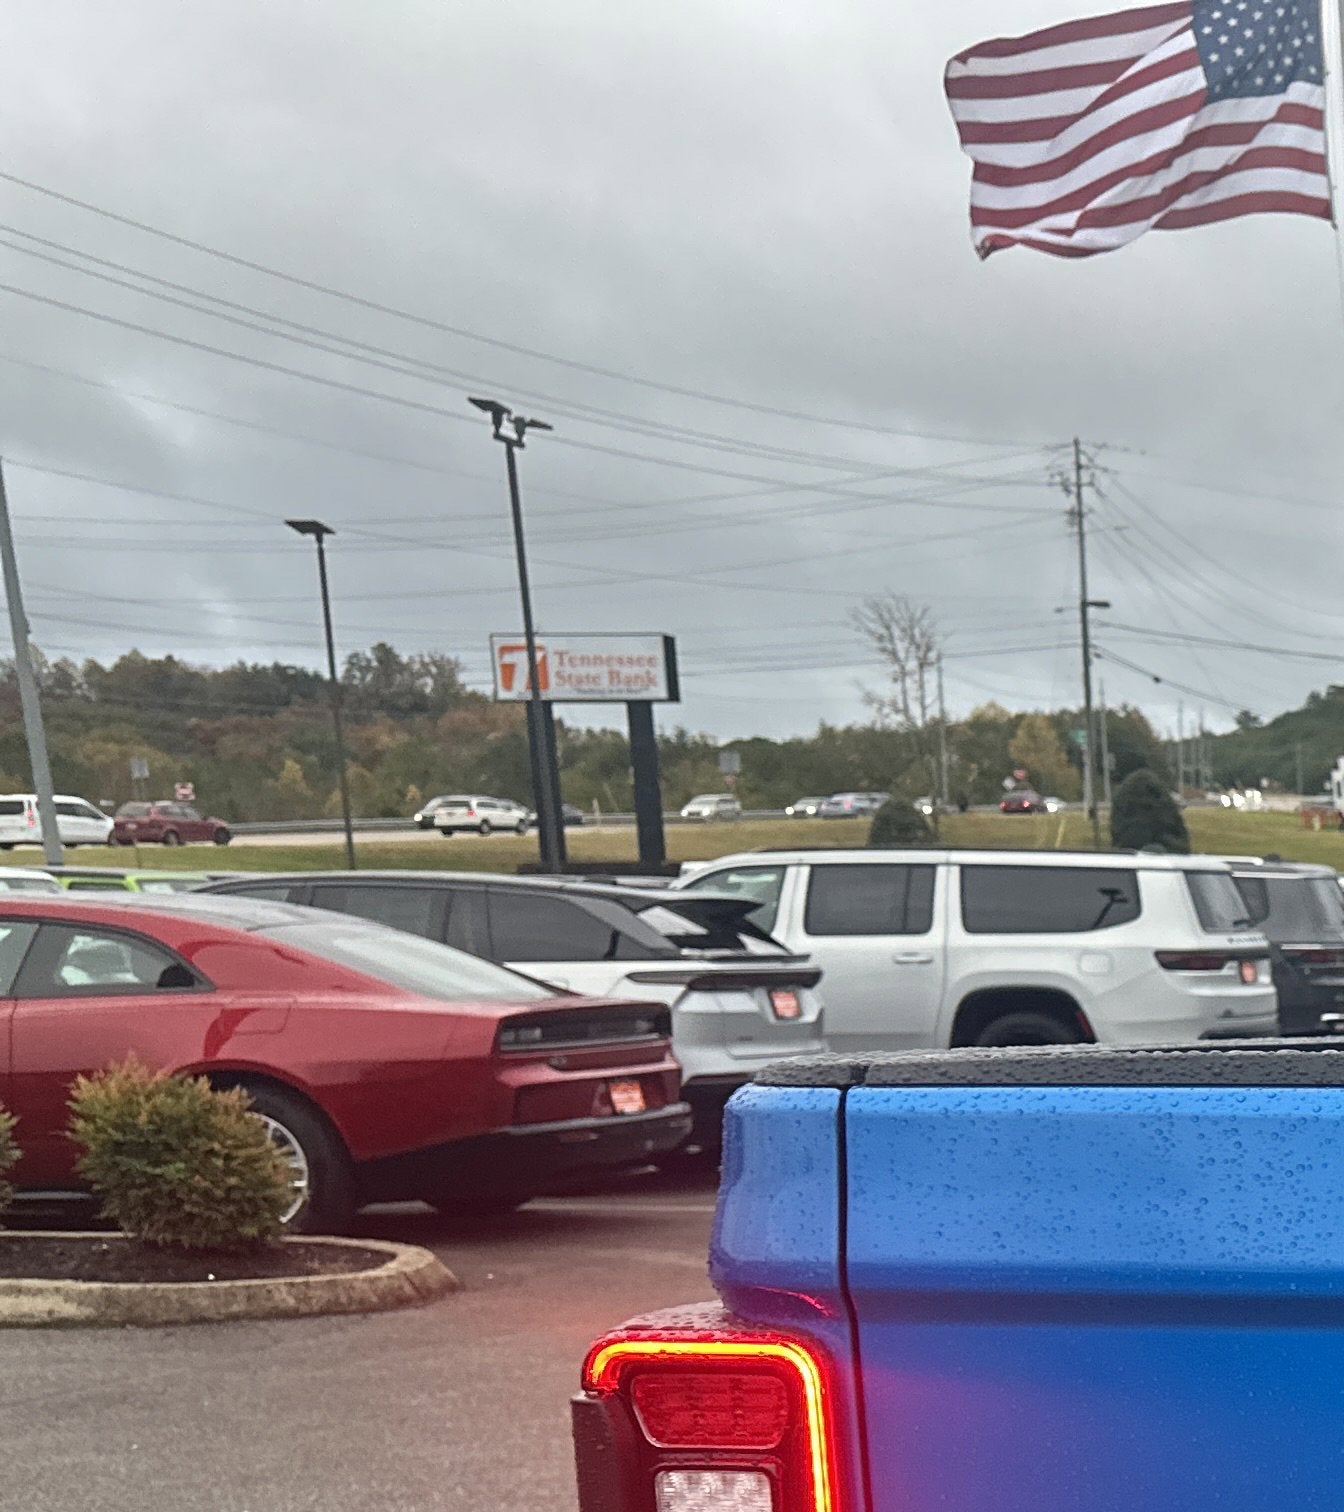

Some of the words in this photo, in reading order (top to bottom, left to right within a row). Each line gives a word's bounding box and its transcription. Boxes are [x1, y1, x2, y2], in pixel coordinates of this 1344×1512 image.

[553, 650, 657, 668] Tennessee
[554, 670, 601, 687] State
[607, 669, 657, 687] Bank
